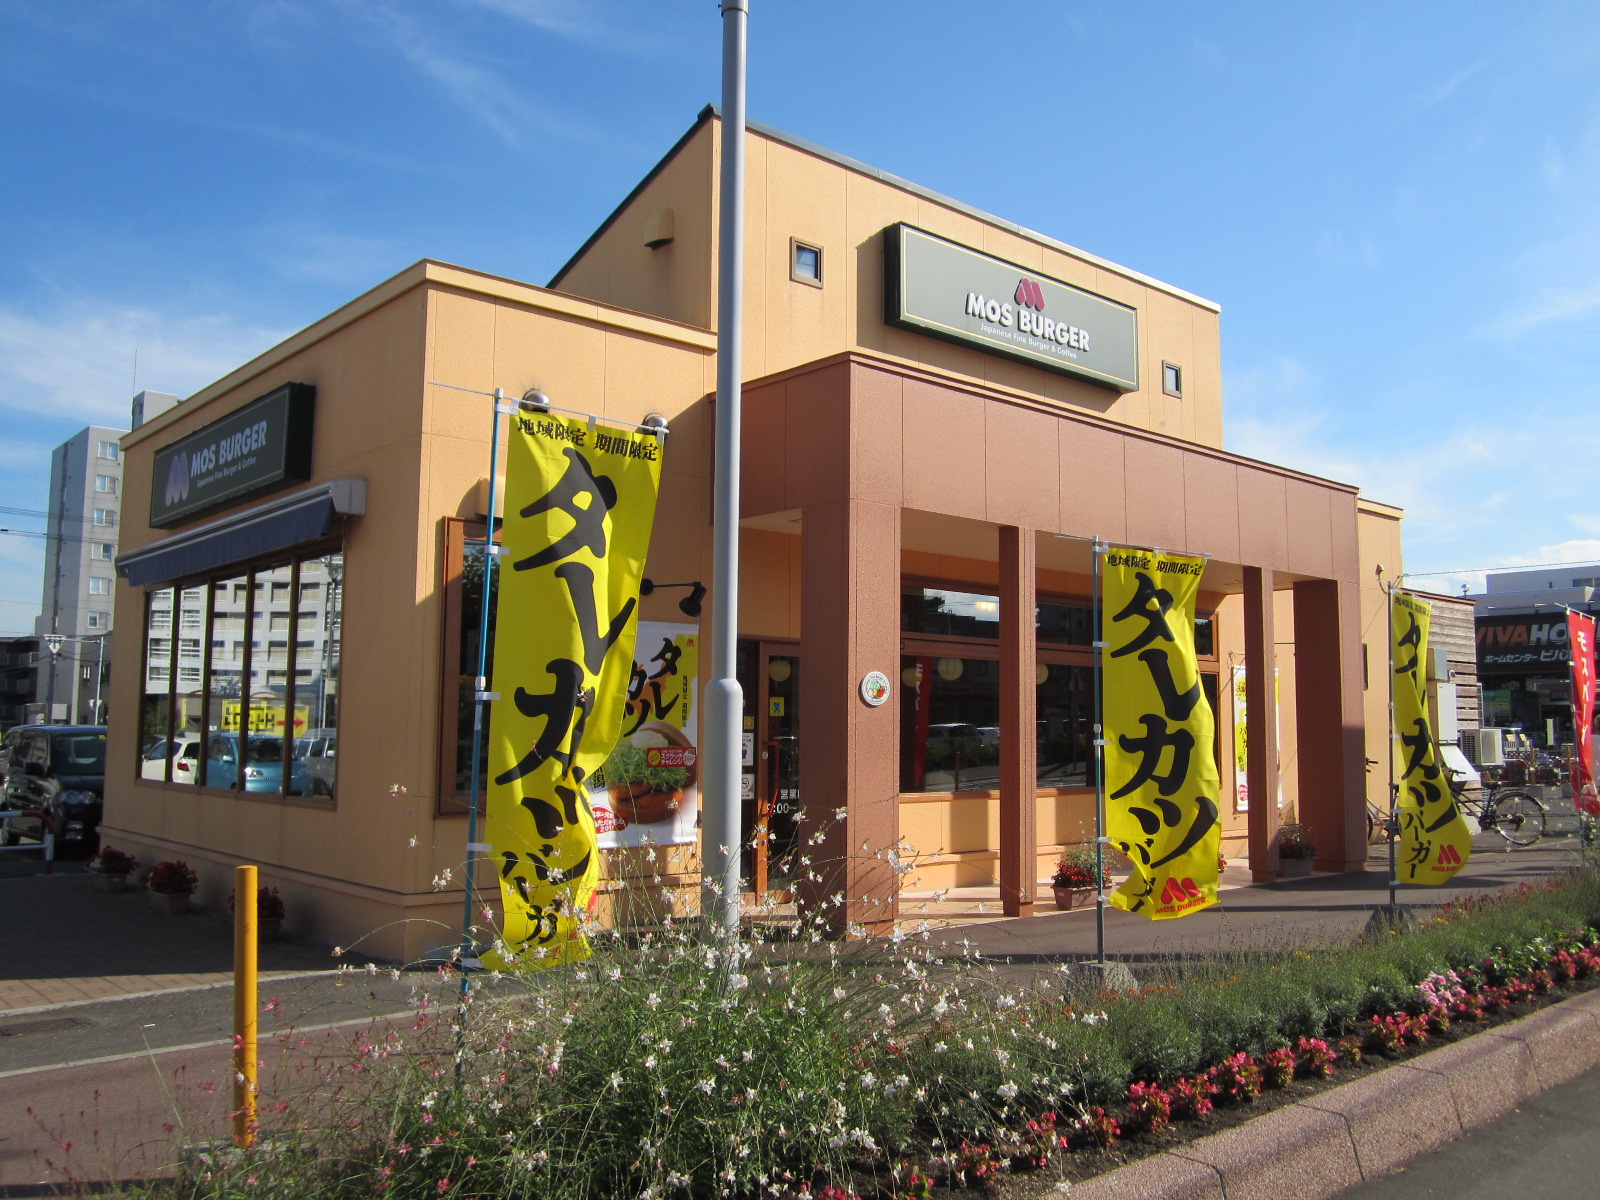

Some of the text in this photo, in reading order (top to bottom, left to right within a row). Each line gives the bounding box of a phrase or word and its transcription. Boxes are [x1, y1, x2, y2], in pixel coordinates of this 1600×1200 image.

[965, 292, 1090, 352] MOS BURGER
[980, 323, 1078, 359] Japanese Fine Burger & Coffee
[190, 420, 267, 478] MOS BURGER
[517, 416, 658, 462] 地域限定 期間限定
[1107, 553, 1202, 575] 地域限定 期間限定
[1475, 623, 1569, 646] VIVAHO
[648, 637, 682, 720] タレ
[1484, 653, 1538, 663] ホームセンター
[1576, 630, 1590, 746] モスバーガ
[1110, 571, 1218, 869] タレカツ
[780, 788, 800, 800] 営業
[1404, 810, 1432, 879] バーガー
[1155, 897, 1206, 914] MOS BURGER
